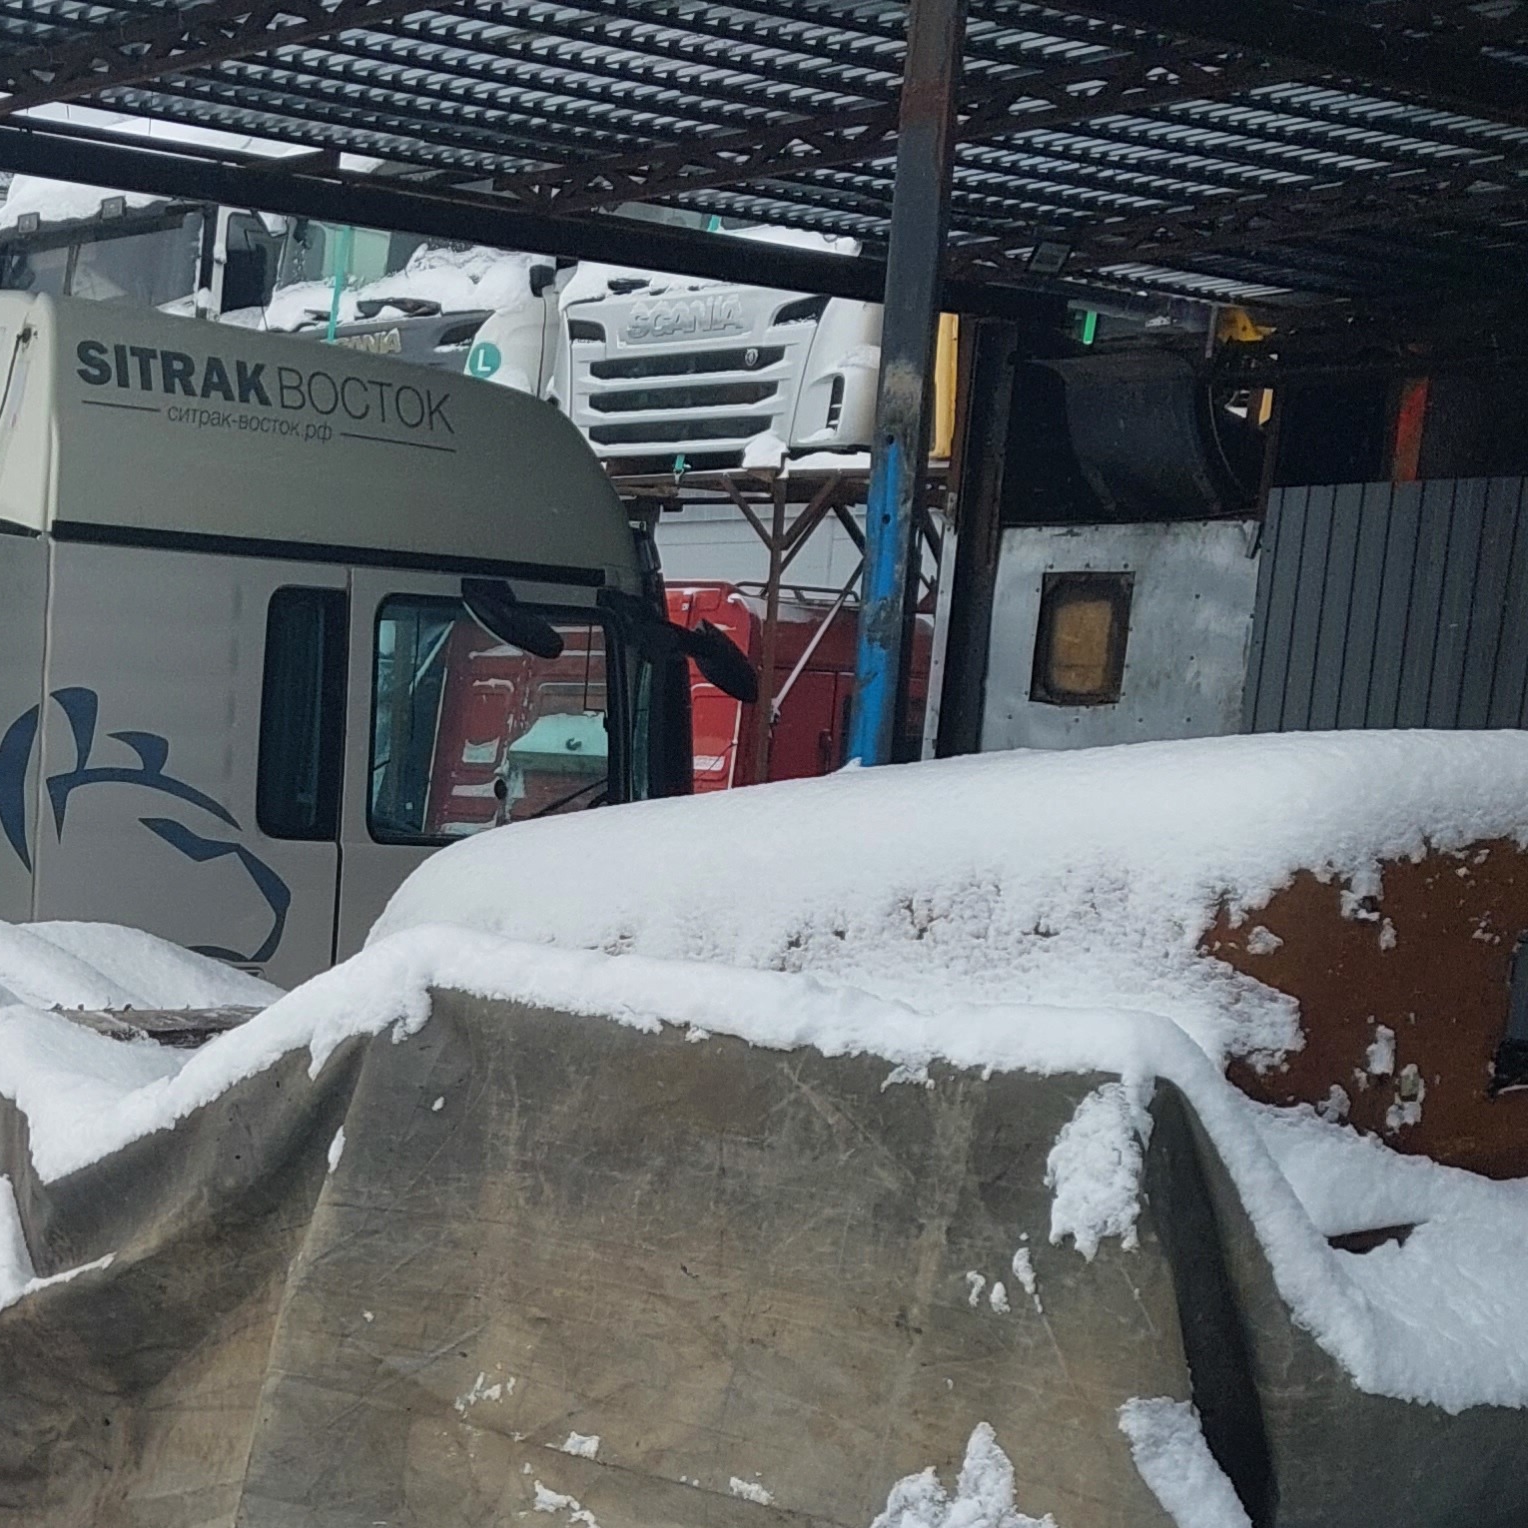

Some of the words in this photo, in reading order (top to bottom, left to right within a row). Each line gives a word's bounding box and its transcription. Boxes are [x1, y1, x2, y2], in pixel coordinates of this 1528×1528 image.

[627, 298, 743, 339] SCANIA
[477, 349, 492, 372] L
[167, 406, 333, 443] ситрак-восток.рф
